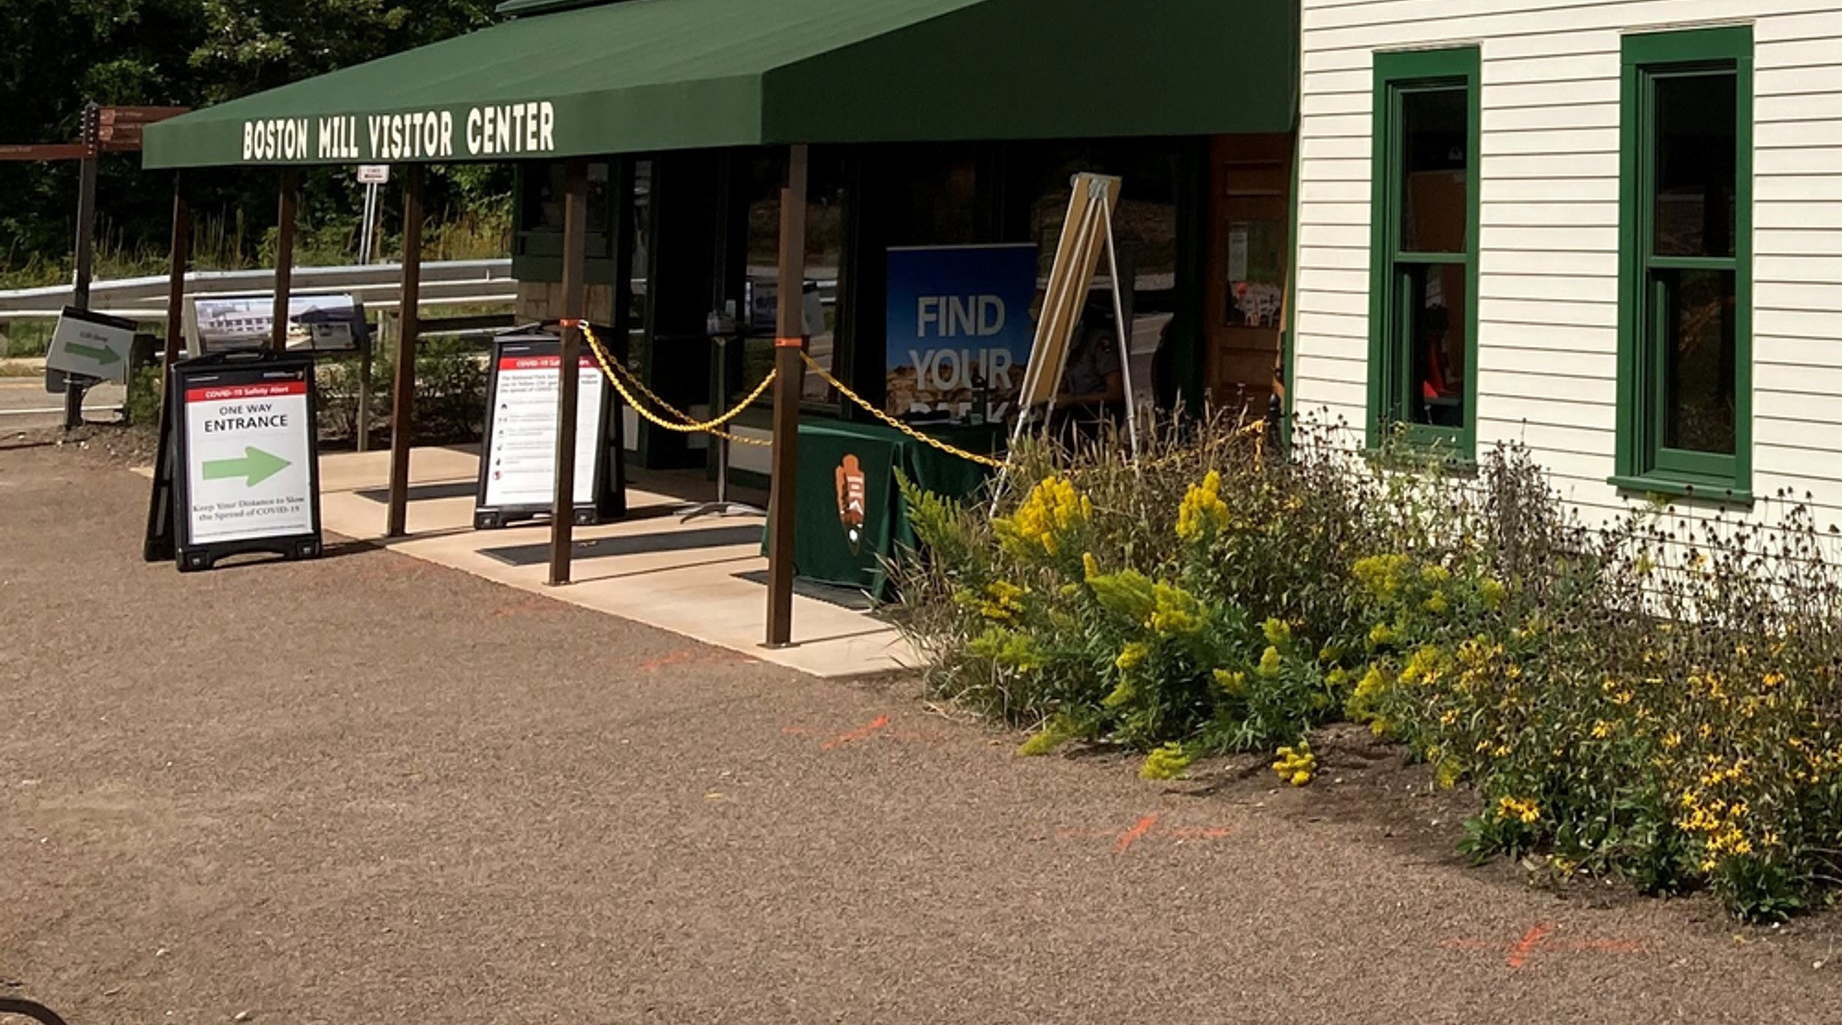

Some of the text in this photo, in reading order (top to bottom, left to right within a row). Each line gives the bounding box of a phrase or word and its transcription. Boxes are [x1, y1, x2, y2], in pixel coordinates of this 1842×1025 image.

[243, 101, 555, 161] BOSTON MILL VISITOR CENTER
[917, 294, 1006, 338] FIND
[908, 348, 1013, 391] YOUR
[205, 389, 242, 398] COVID-19
[244, 387, 268, 396] Safety
[219, 403, 273, 416] ONE WAY
[204, 415, 288, 432] ENTRANCE
[238, 499, 274, 508] Distance
[214, 509, 244, 521] Spread
[256, 505, 300, 516] COVID-19
